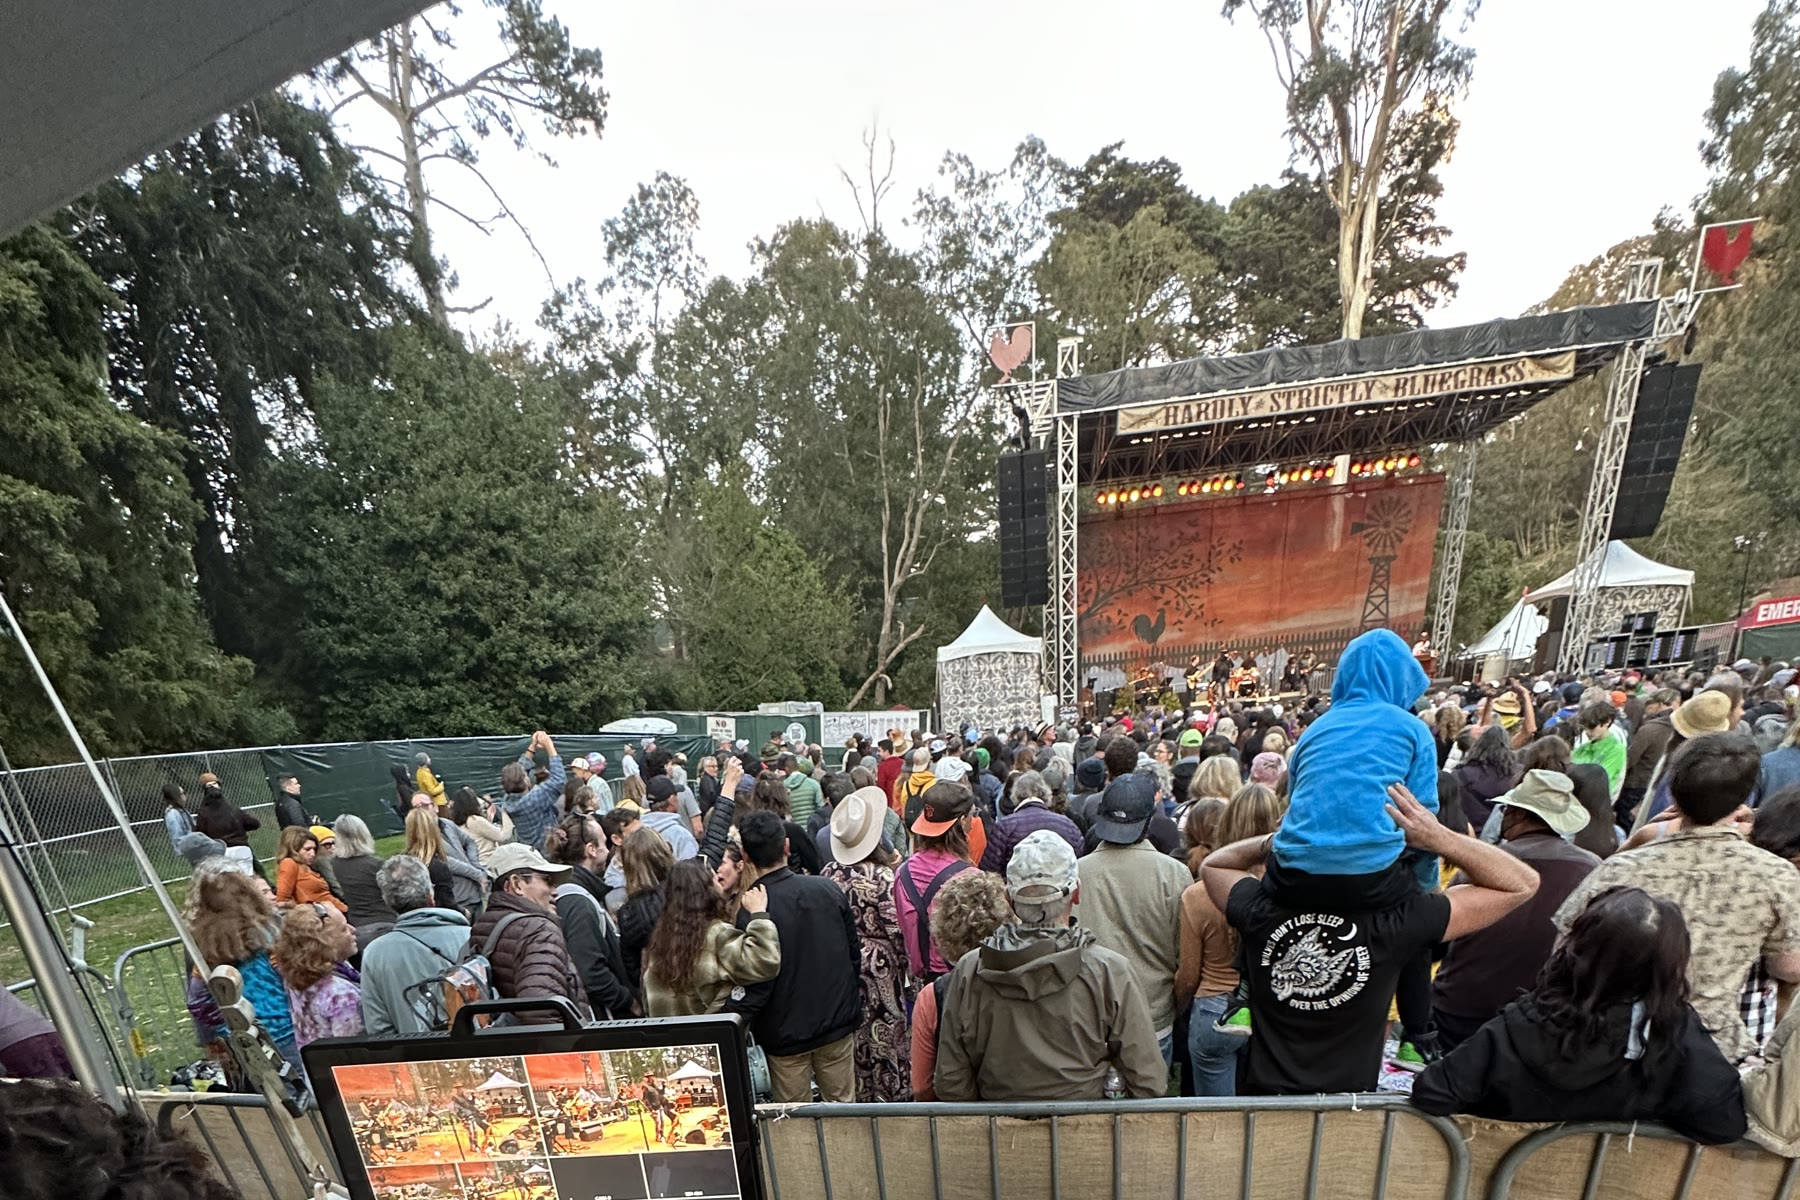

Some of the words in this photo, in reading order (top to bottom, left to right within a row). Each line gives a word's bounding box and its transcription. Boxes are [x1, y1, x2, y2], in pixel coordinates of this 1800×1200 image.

[1164, 396, 1254, 426] HARDLY
[1270, 379, 1378, 413] STRICTLY
[1393, 358, 1527, 398] BLUEGRASS
[715, 719, 727, 728] NO
[1270, 919, 1294, 942] DON'T
[1294, 913, 1316, 926] LOSE
[1316, 913, 1344, 928] SLEEP
[1355, 945, 1371, 971] SHEEP
[1356, 971, 1370, 982] OF
[1329, 981, 1365, 1007] OPINIONS
[1289, 999, 1311, 1010] OVER
[1311, 1000, 1330, 1010] THE
